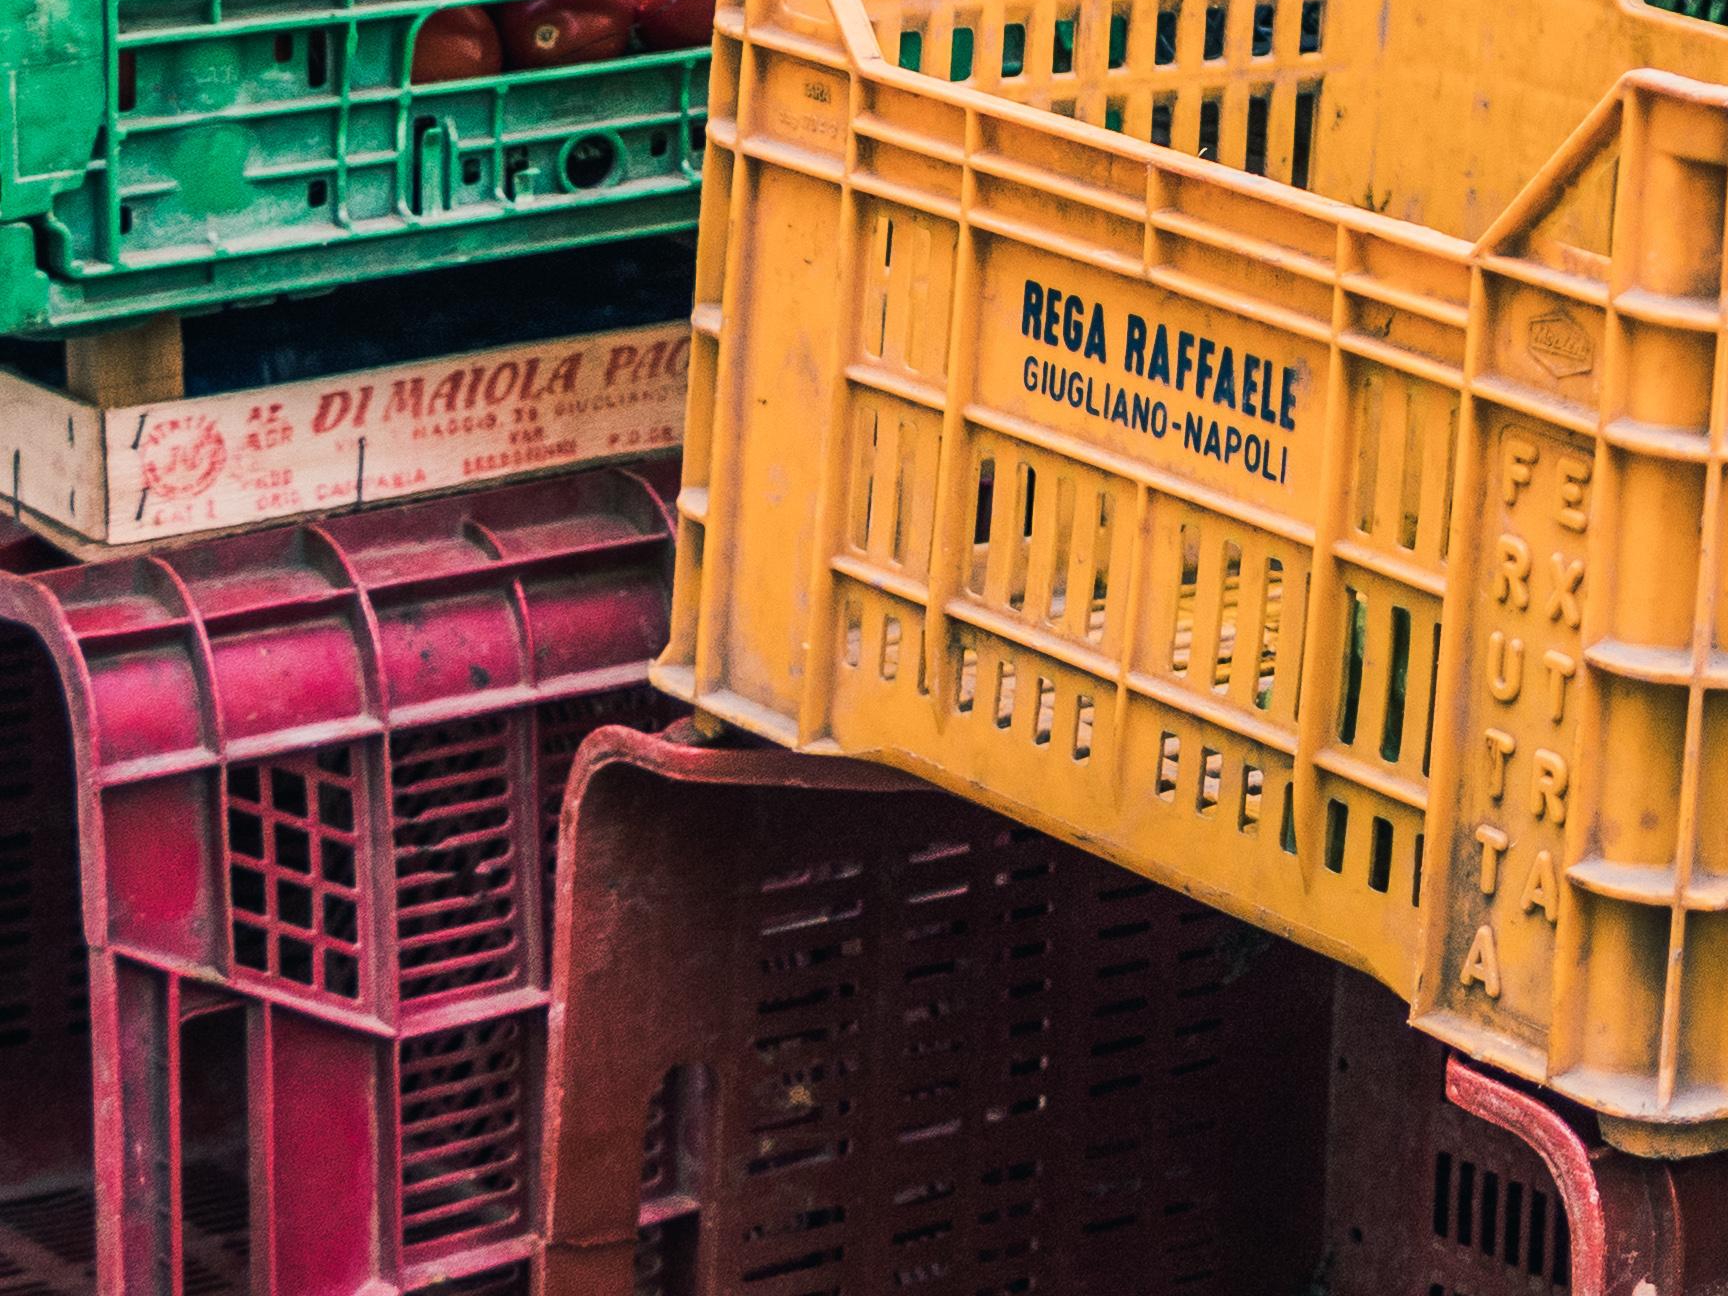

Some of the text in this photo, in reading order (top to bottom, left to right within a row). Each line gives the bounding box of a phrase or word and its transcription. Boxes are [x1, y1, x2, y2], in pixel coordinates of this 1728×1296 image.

[311, 385, 374, 435] DI
[382, 352, 585, 422] MAIOLA
[1021, 278, 1297, 432] REGA RAFFAELE
[1459, 439, 1541, 998] FRUTTA
[1519, 458, 1593, 922] EXTRA
